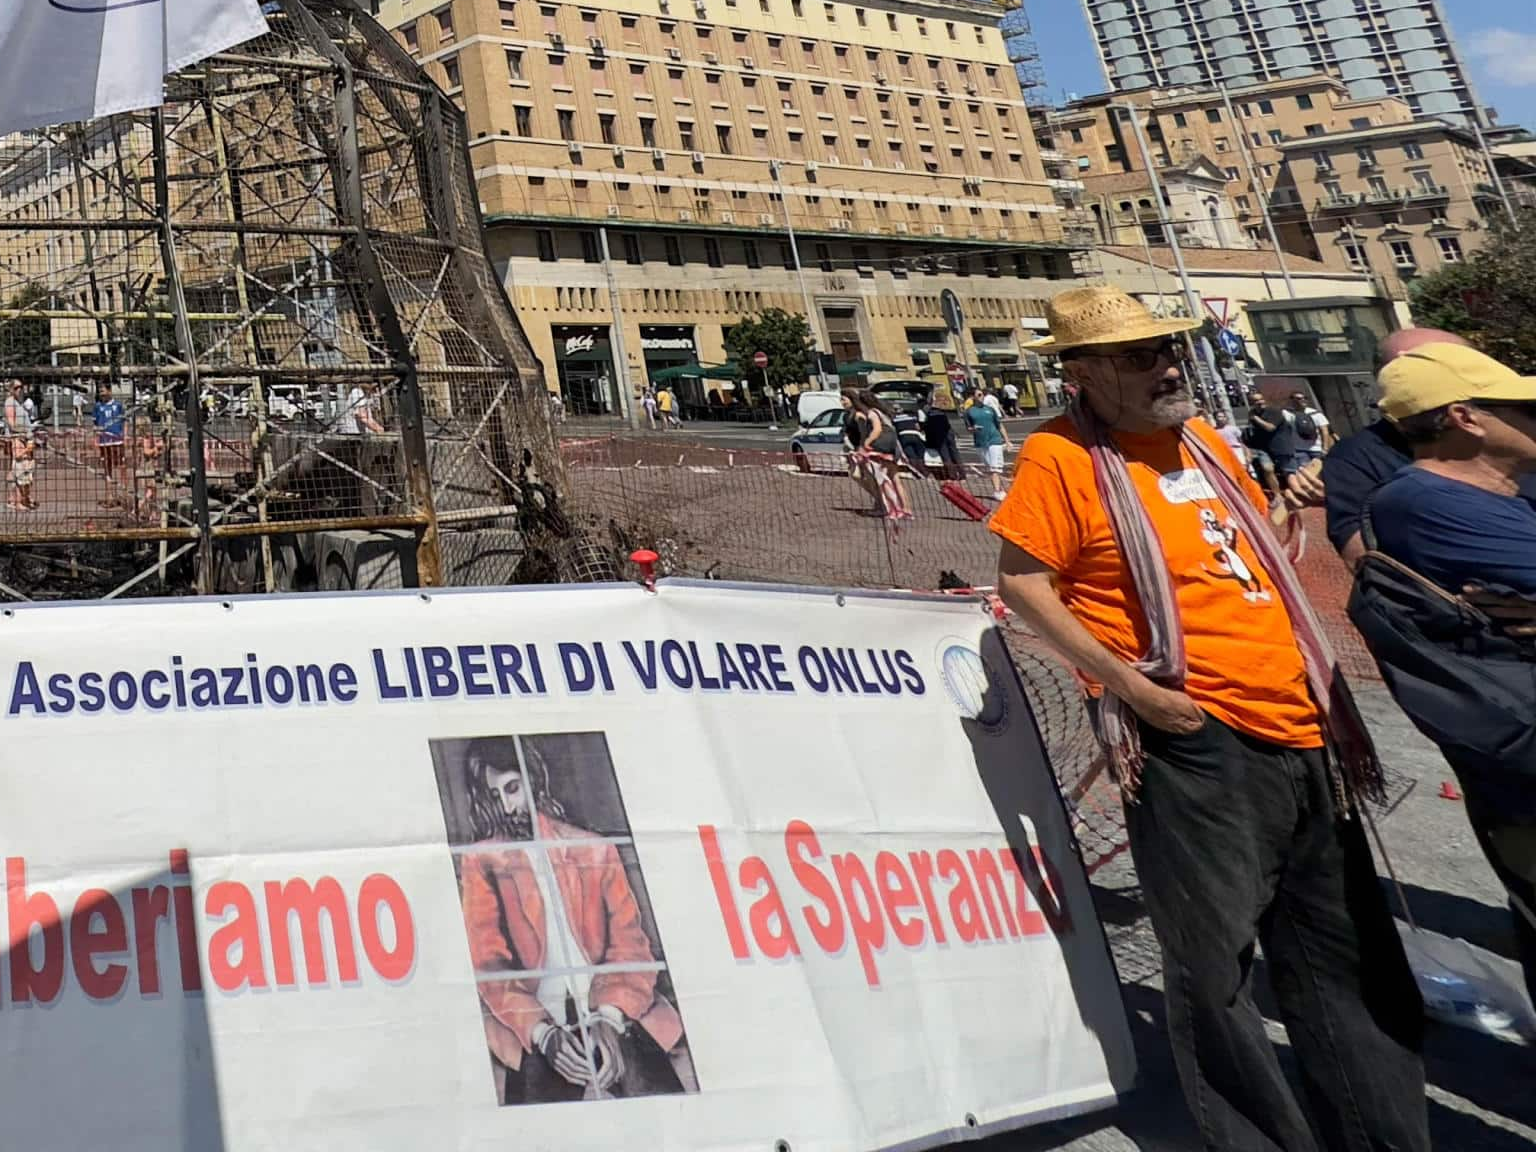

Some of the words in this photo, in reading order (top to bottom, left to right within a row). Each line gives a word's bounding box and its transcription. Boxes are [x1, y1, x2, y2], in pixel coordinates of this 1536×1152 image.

[8, 652, 358, 715] Associazione
[372, 643, 546, 699] LIBERI
[557, 641, 615, 692] DI
[624, 639, 794, 692] VOLARE
[799, 645, 927, 695] ONLUS
